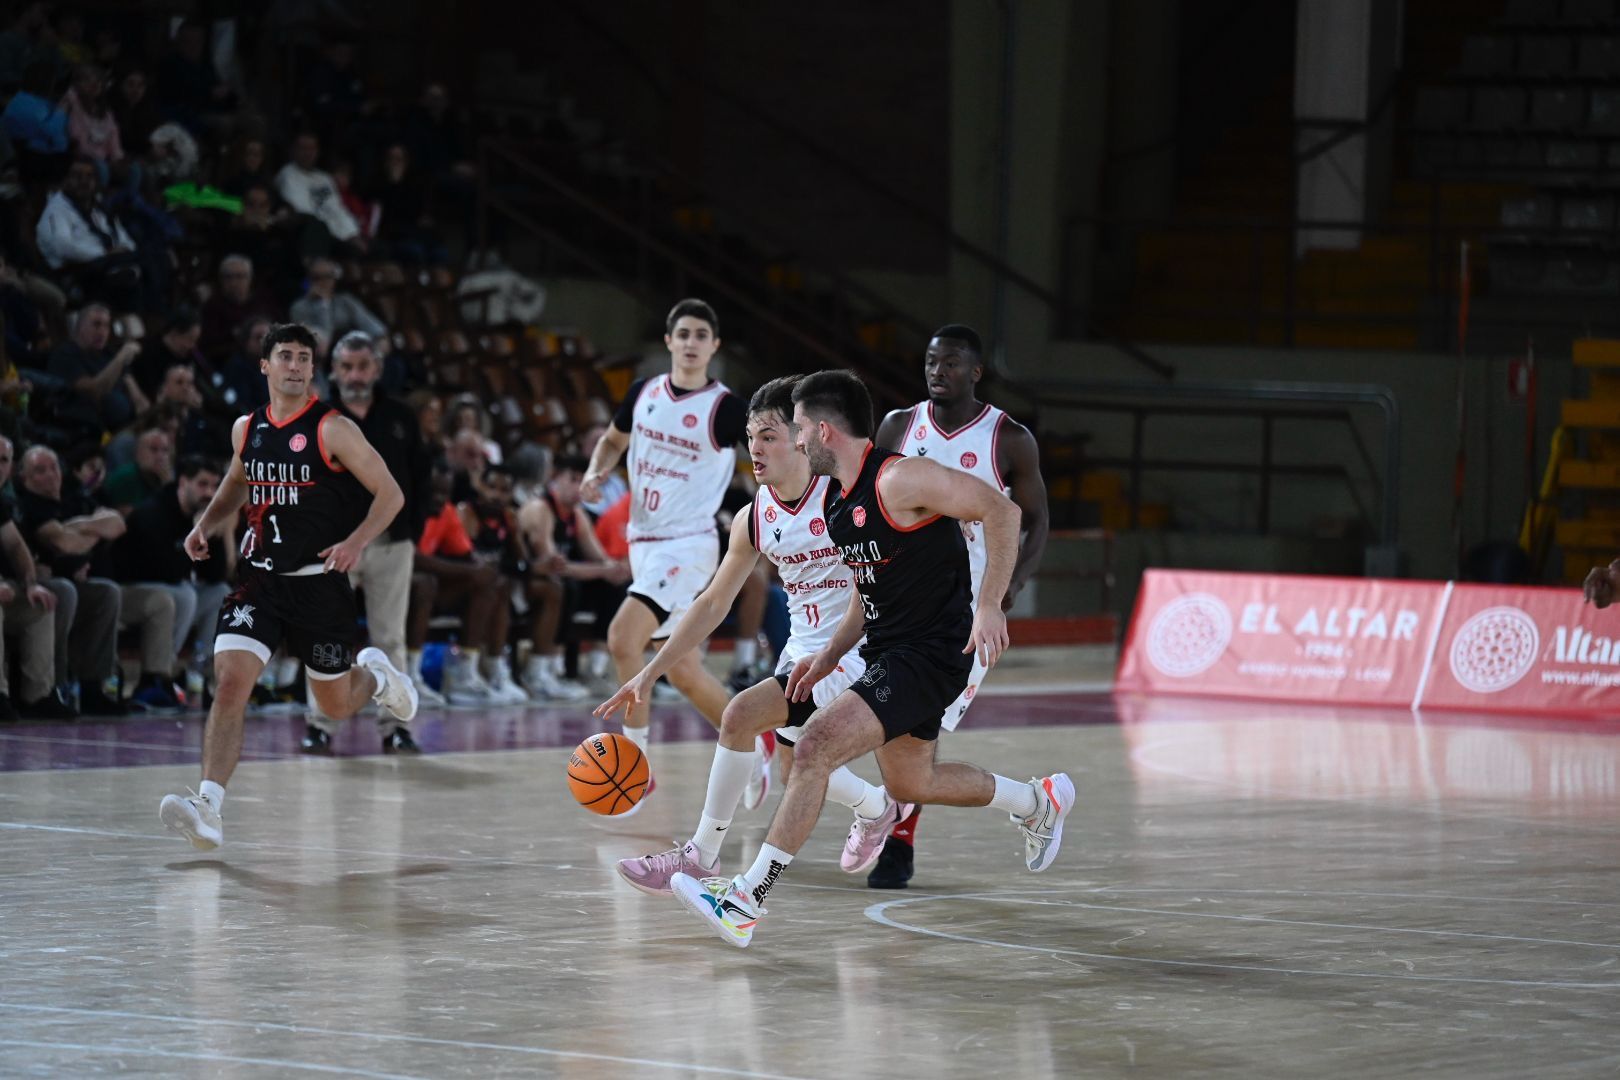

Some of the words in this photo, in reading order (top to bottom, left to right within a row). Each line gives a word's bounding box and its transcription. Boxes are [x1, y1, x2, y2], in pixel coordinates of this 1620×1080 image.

[643, 487, 660, 511] 10
[269, 514, 282, 543] 1
[782, 552, 809, 565] CAJA
[809, 545, 841, 561] RURA
[802, 604, 820, 629] 11
[1240, 603, 1281, 633] EL
[1294, 607, 1419, 641] ALTAR
